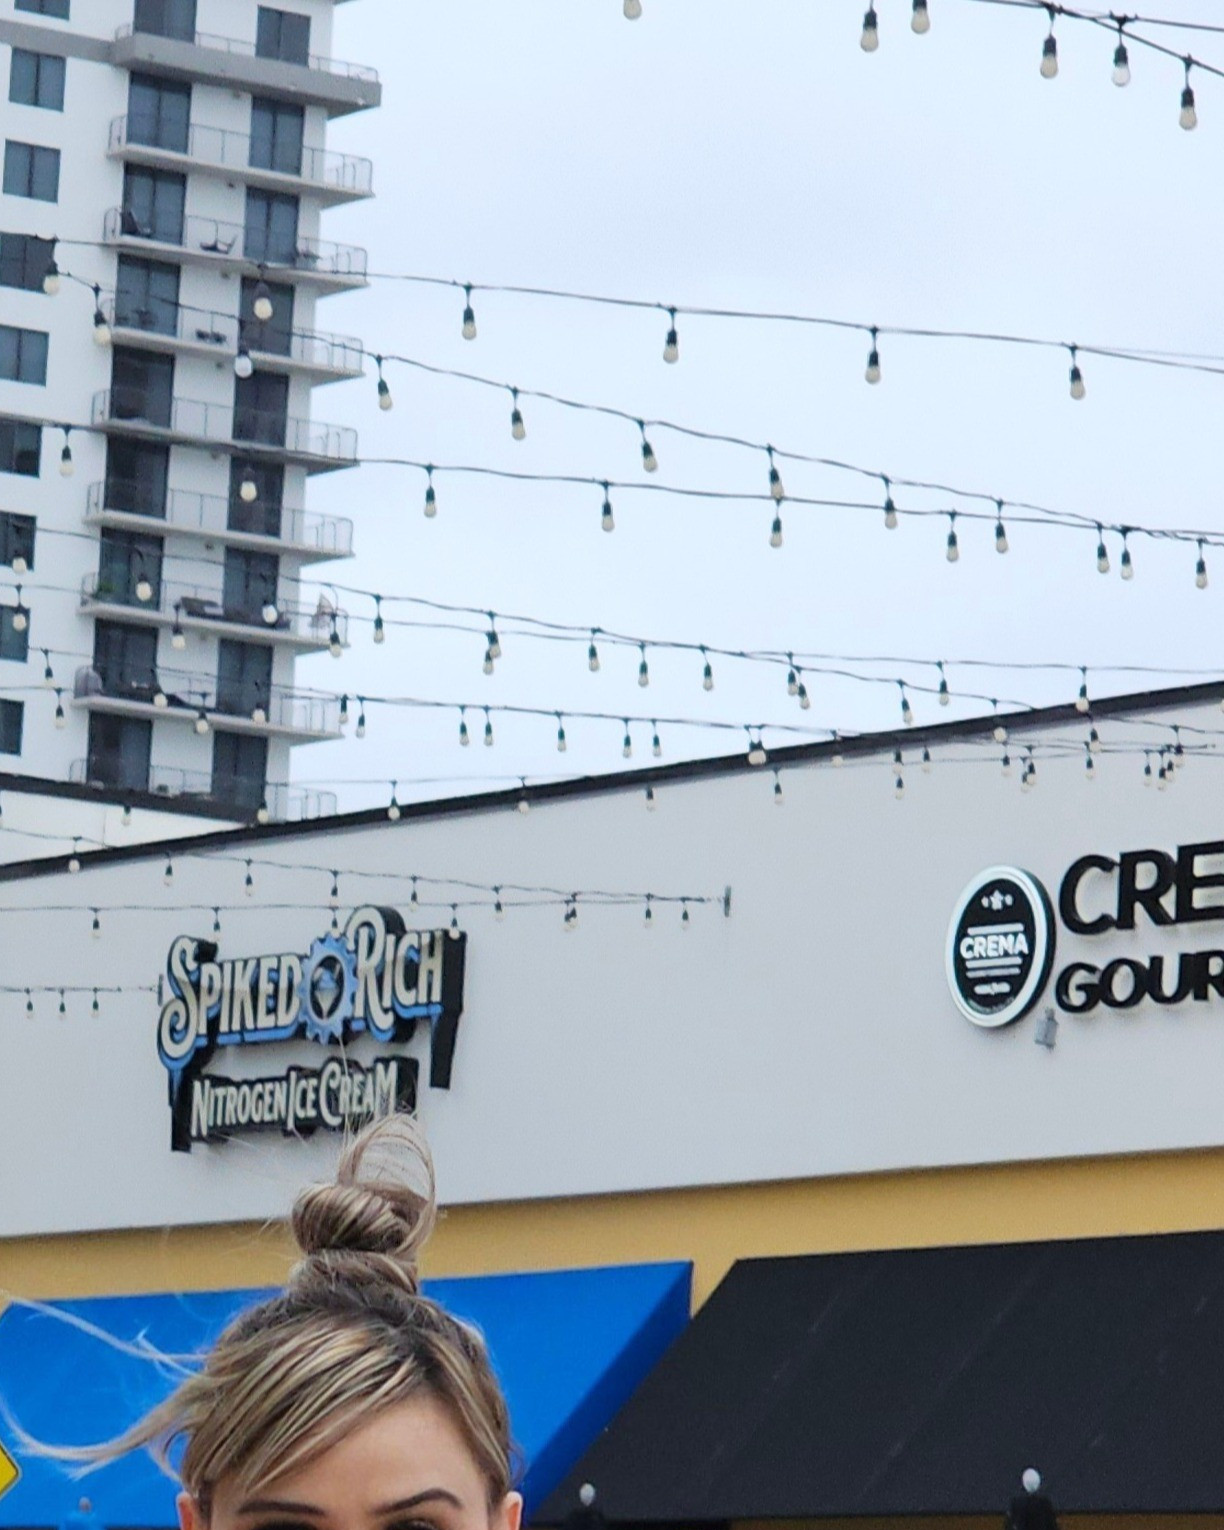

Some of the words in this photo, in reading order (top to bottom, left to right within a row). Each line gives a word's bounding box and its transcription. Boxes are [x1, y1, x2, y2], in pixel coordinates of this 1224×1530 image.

[1058, 840, 1224, 935] CRE
[158, 935, 304, 1062] SPIKED
[345, 905, 444, 1032] RICH
[959, 933, 1029, 959] CRENA
[1055, 949, 1224, 1013] GOUR
[190, 1078, 288, 1138] NITROGEN
[285, 1070, 318, 1131] ICE
[319, 1059, 399, 1128] CREAM
